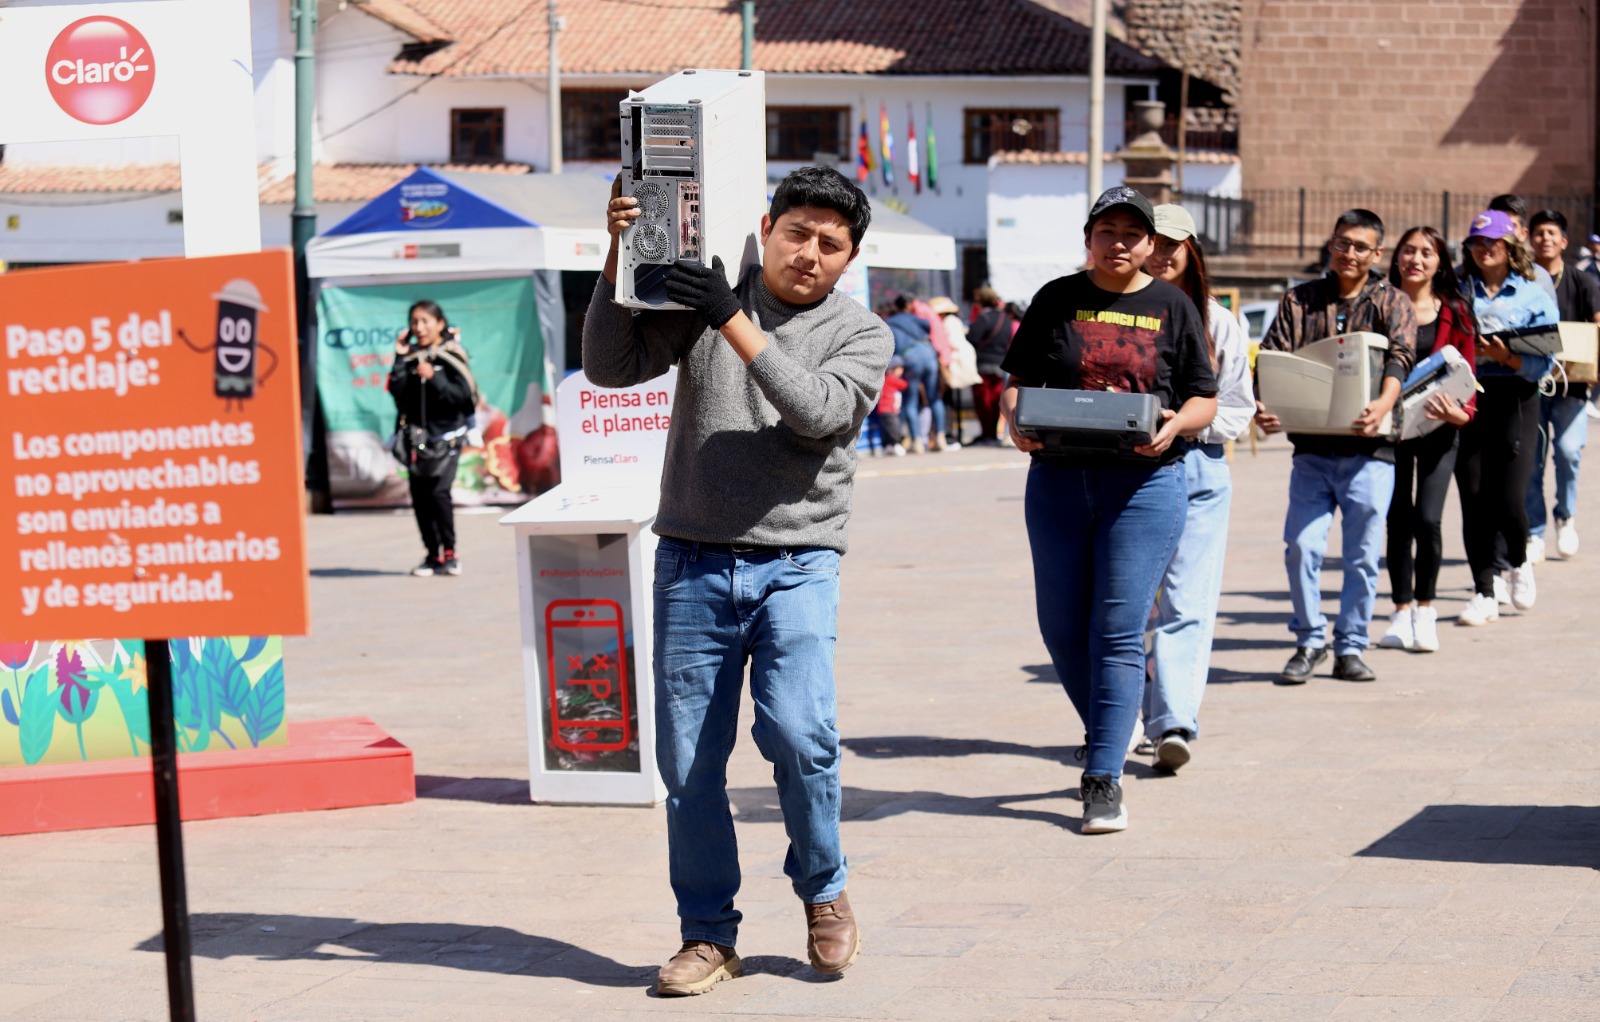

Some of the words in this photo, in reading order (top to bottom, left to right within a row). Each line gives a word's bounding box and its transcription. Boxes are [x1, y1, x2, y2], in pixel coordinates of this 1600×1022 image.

[52, 48, 147, 84] Claro
[6, 325, 85, 358] Paso
[91, 316, 112, 352] 5
[118, 310, 172, 350] del
[1076, 309, 1096, 321] ONE
[1097, 311, 1135, 327] PUNCH
[1136, 315, 1161, 331] MAN
[7, 352, 161, 396] reciclaje:
[580, 390, 641, 409] Piensa
[645, 391, 668, 406] en
[13, 432, 60, 459] Los
[64, 421, 255, 460] componentes
[582, 414, 599, 434] el
[603, 413, 671, 438] planeta
[15, 473, 51, 497] no
[56, 455, 260, 500] aprovechables
[583, 454, 638, 464] PiensaClaro
[17, 509, 67, 535] son
[71, 498, 199, 531] enviados
[203, 502, 221, 525] a
[20, 540, 132, 571] rellenos
[136, 532, 280, 566] sanitarios
[22, 584, 40, 615] y
[44, 577, 79, 607] de
[83, 571, 234, 612] seguridad.
